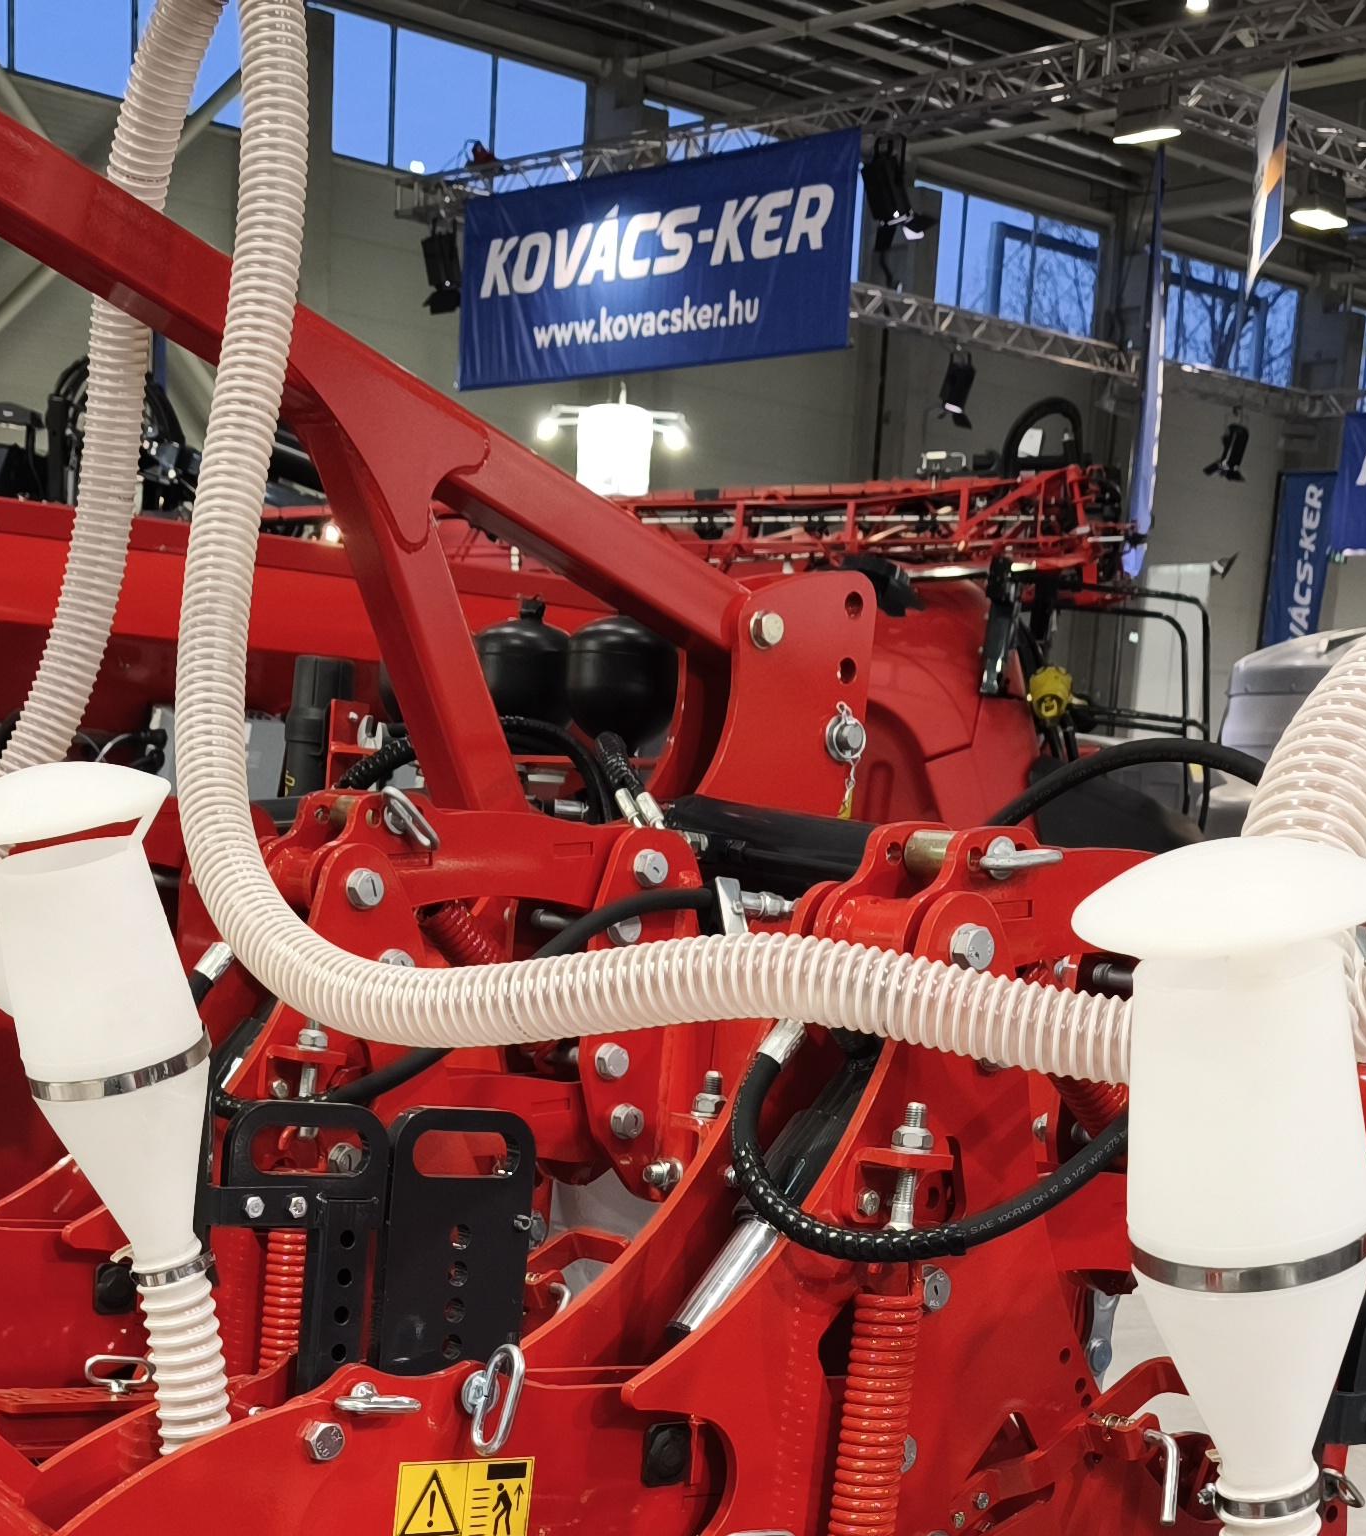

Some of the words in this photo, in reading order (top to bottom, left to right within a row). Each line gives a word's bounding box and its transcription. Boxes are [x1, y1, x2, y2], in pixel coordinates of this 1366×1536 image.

[480, 183, 836, 299] KOVÁCS-KER
[533, 289, 760, 350] www.kovacsker.hu
[969, 1219, 996, 1235] SAE
[997, 1201, 1032, 1224] 100R16
[1032, 1191, 1049, 1206] DN
[1049, 1184, 1060, 1195] 12
[1104, 1137, 1120, 1152] 275
